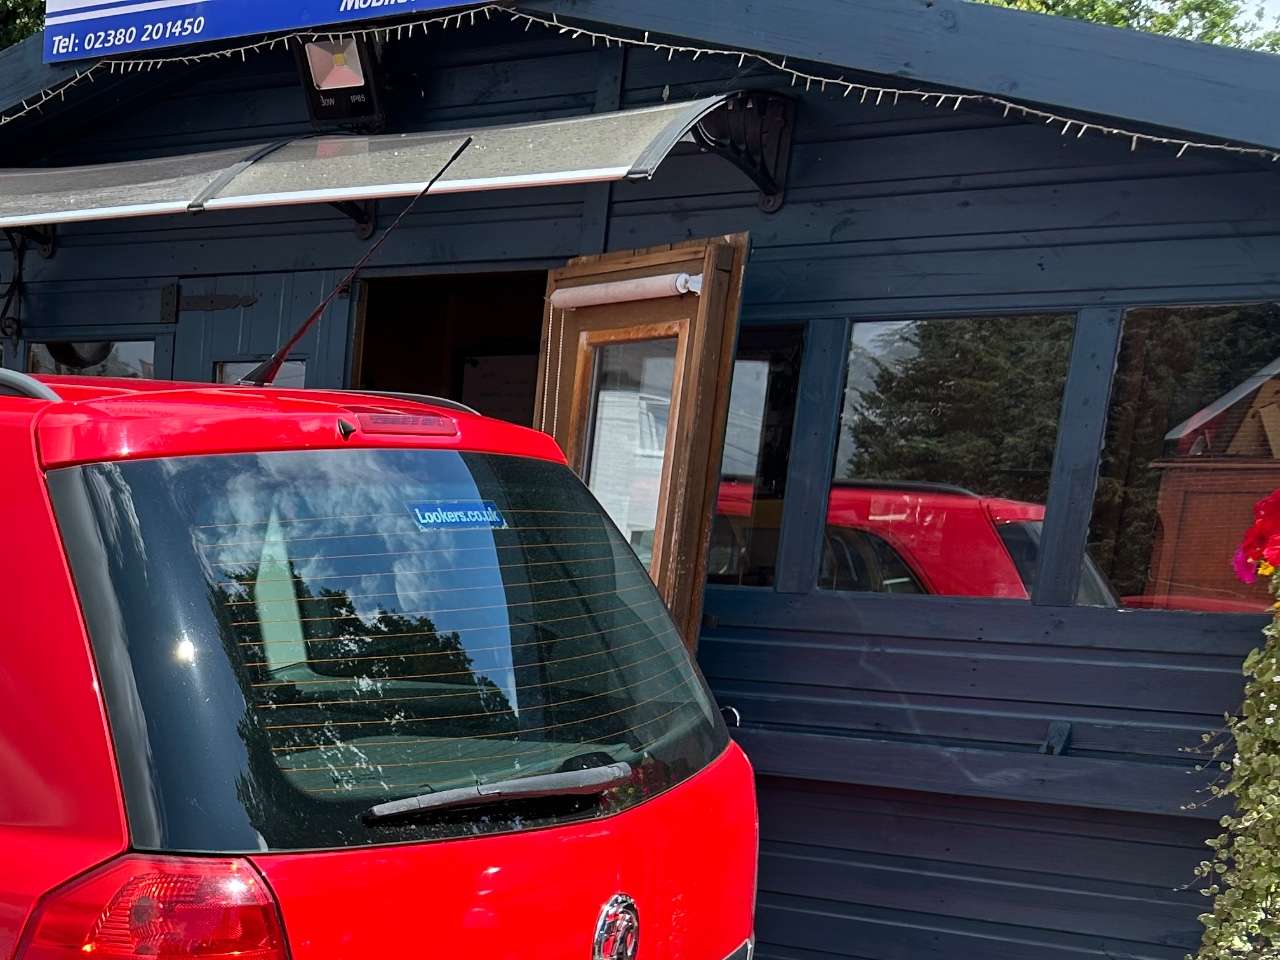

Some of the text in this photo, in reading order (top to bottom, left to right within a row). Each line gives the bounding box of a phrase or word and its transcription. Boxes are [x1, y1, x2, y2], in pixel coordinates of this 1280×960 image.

[52, 16, 205, 55] Tel: 02380 201450
[414, 506, 501, 524] Lookers.co.uk
